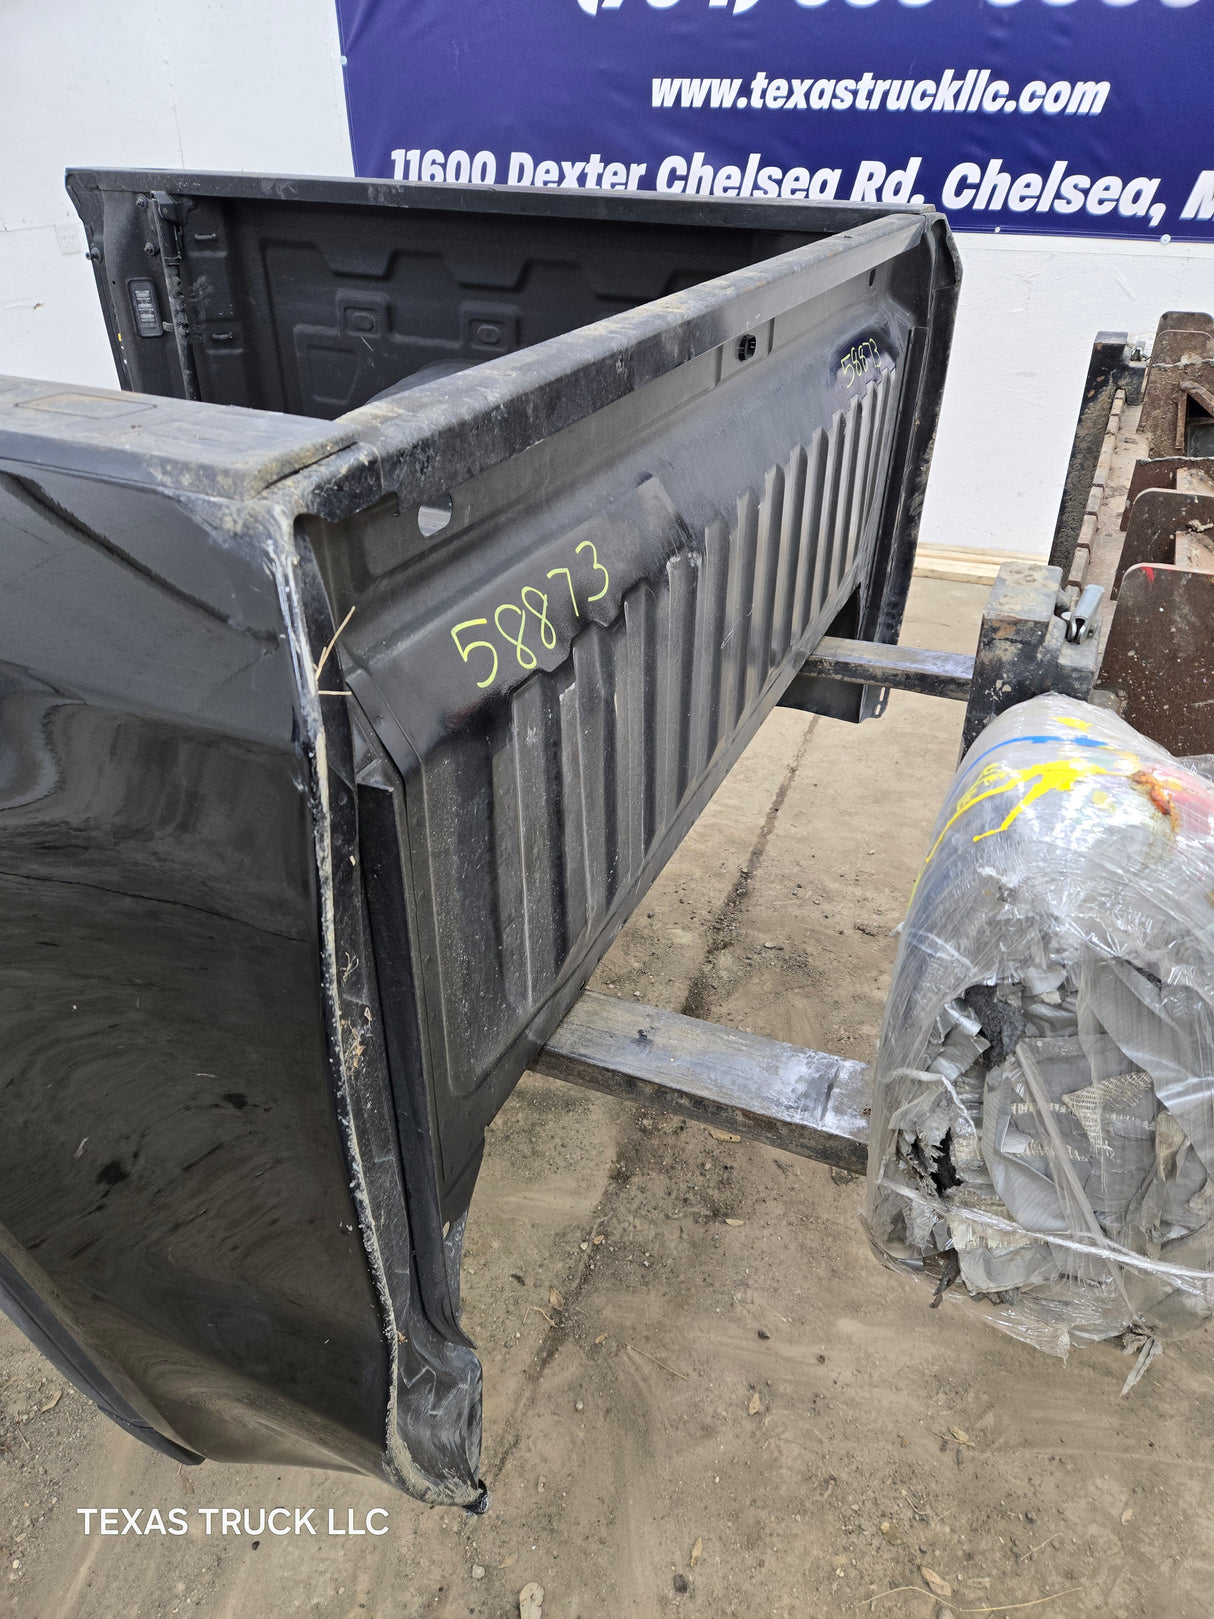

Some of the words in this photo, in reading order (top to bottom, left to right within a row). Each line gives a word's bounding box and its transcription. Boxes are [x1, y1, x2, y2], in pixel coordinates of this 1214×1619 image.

[651, 69, 1111, 116] www.texastruckllc.com
[391, 149, 497, 184] 11600
[507, 151, 647, 190] Dexter
[656, 152, 842, 200] Chelsea
[850, 157, 925, 204] Rd.
[941, 159, 1167, 227] Chelsea,
[840, 338, 881, 388] 58873
[451, 540, 609, 688] 58873
